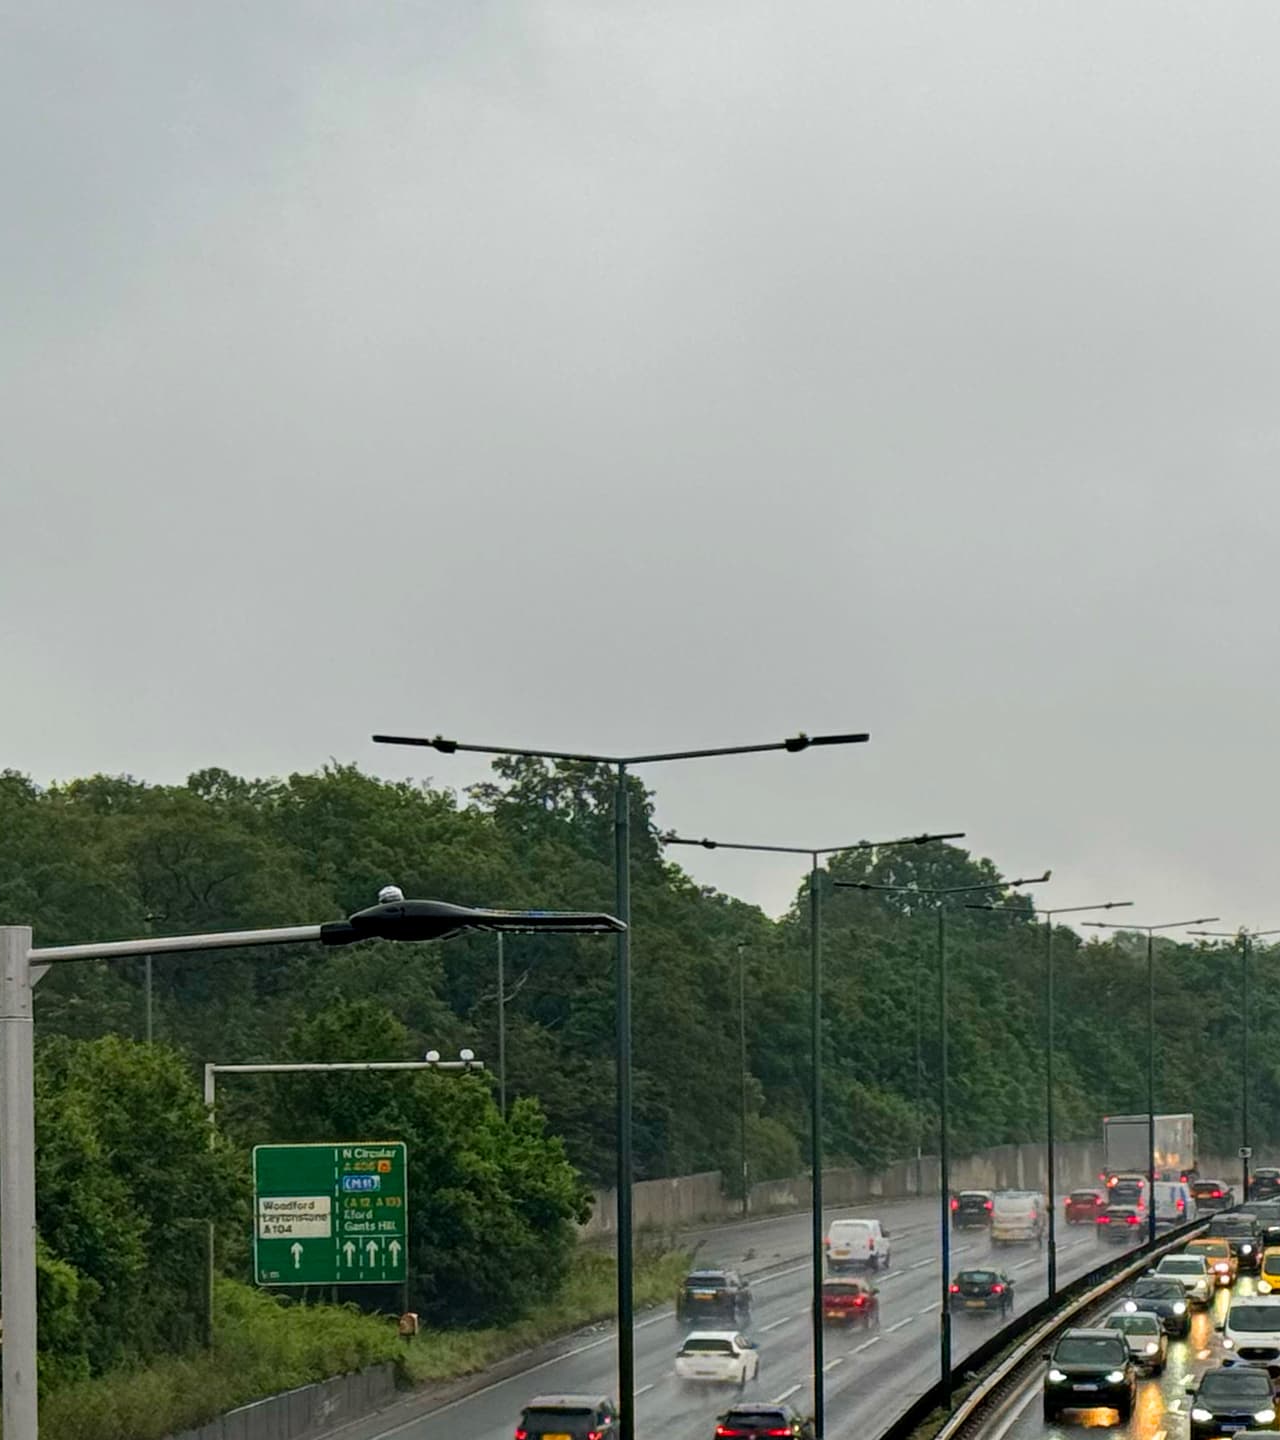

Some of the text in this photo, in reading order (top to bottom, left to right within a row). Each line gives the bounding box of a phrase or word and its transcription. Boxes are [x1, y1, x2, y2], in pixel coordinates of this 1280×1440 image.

[343, 1148, 397, 1159] N Circular
[263, 1201, 315, 1210] Woodford
[263, 1213, 328, 1223] Leytonstone
[344, 1209, 373, 1219] Ilford
[344, 1221, 396, 1231] Gants Hill
